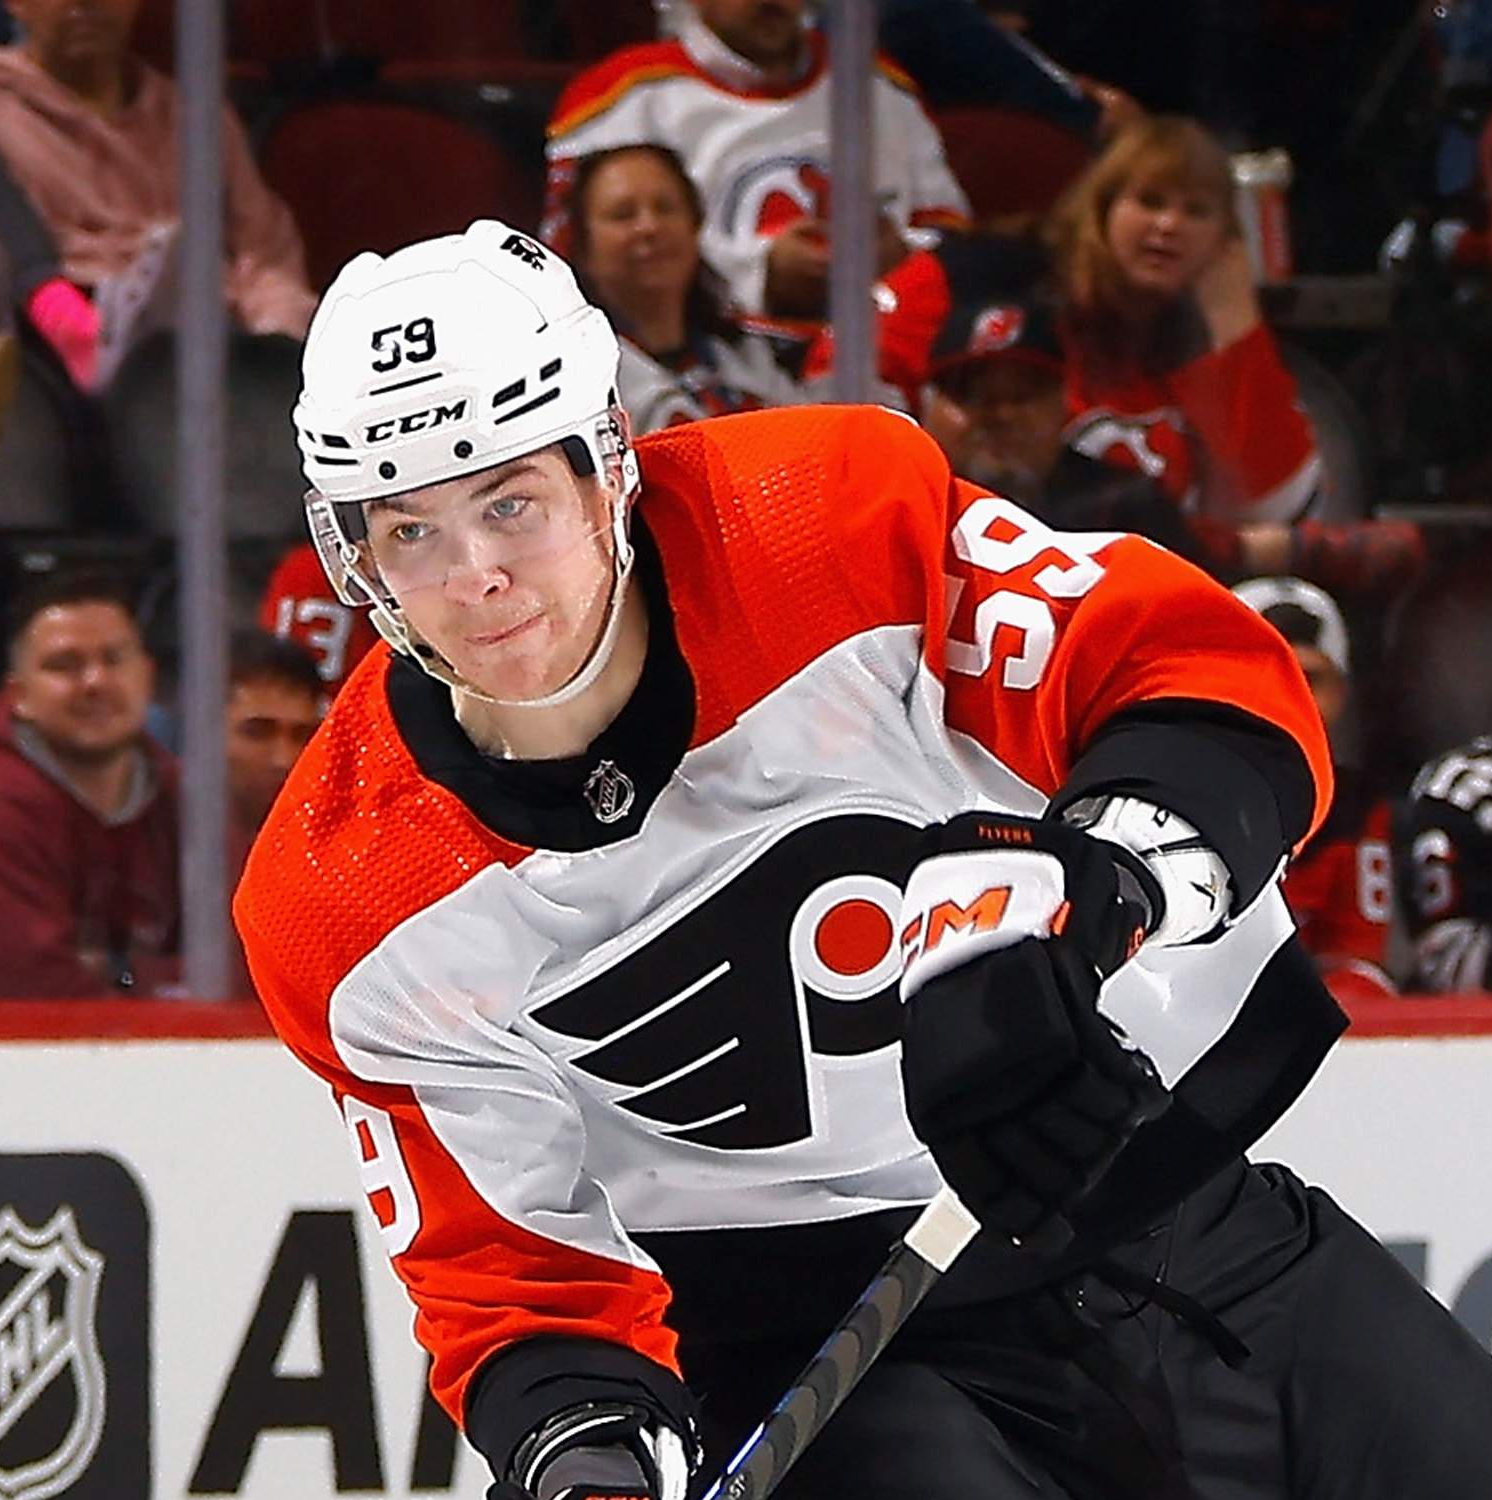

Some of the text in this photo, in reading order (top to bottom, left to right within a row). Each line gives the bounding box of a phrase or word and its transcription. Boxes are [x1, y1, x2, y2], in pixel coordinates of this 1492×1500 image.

[371, 316, 438, 374] 59
[365, 399, 467, 443] CCM
[943, 496, 1130, 690] 59
